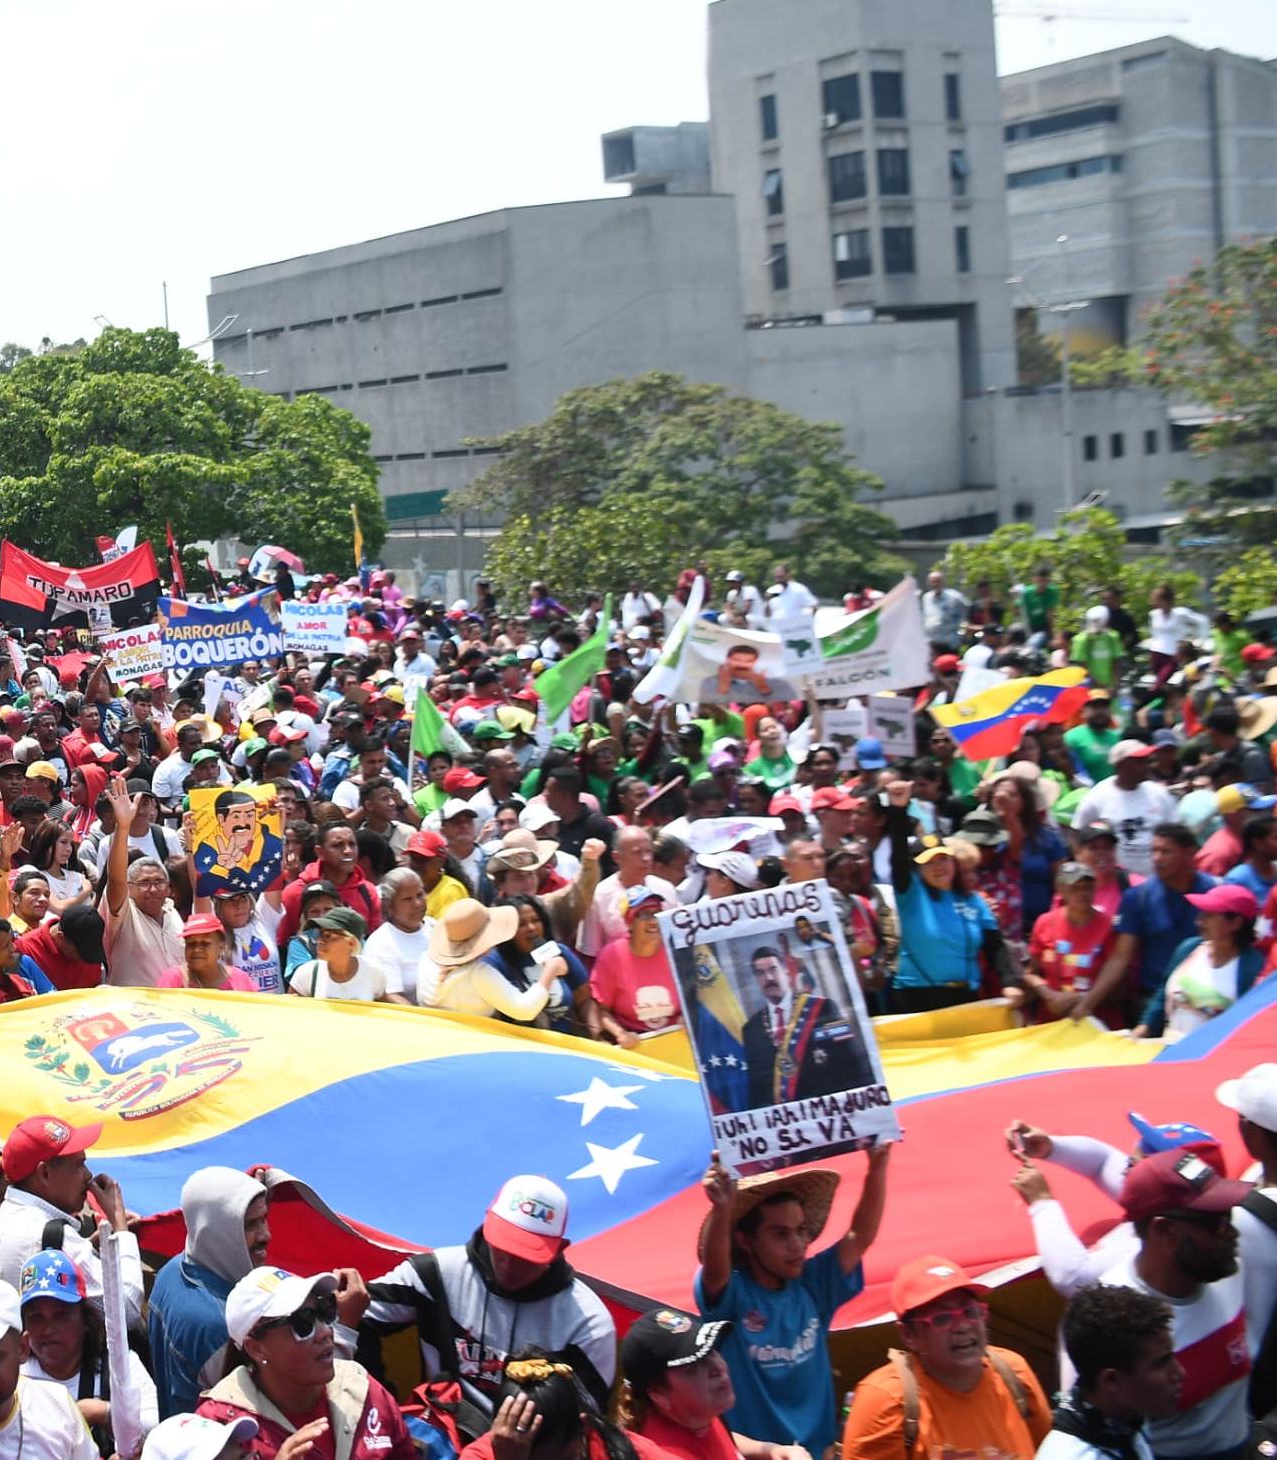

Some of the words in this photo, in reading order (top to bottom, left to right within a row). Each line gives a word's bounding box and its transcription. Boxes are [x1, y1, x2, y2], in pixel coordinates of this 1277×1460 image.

[28, 576, 132, 603] TUPAMARO
[285, 603, 344, 615] NICOLAS
[165, 620, 253, 641] PARROQUIA
[161, 628, 285, 668] BOQUERÓN
[116, 661, 162, 676] MONAGAS
[818, 1116, 857, 1142] VA
